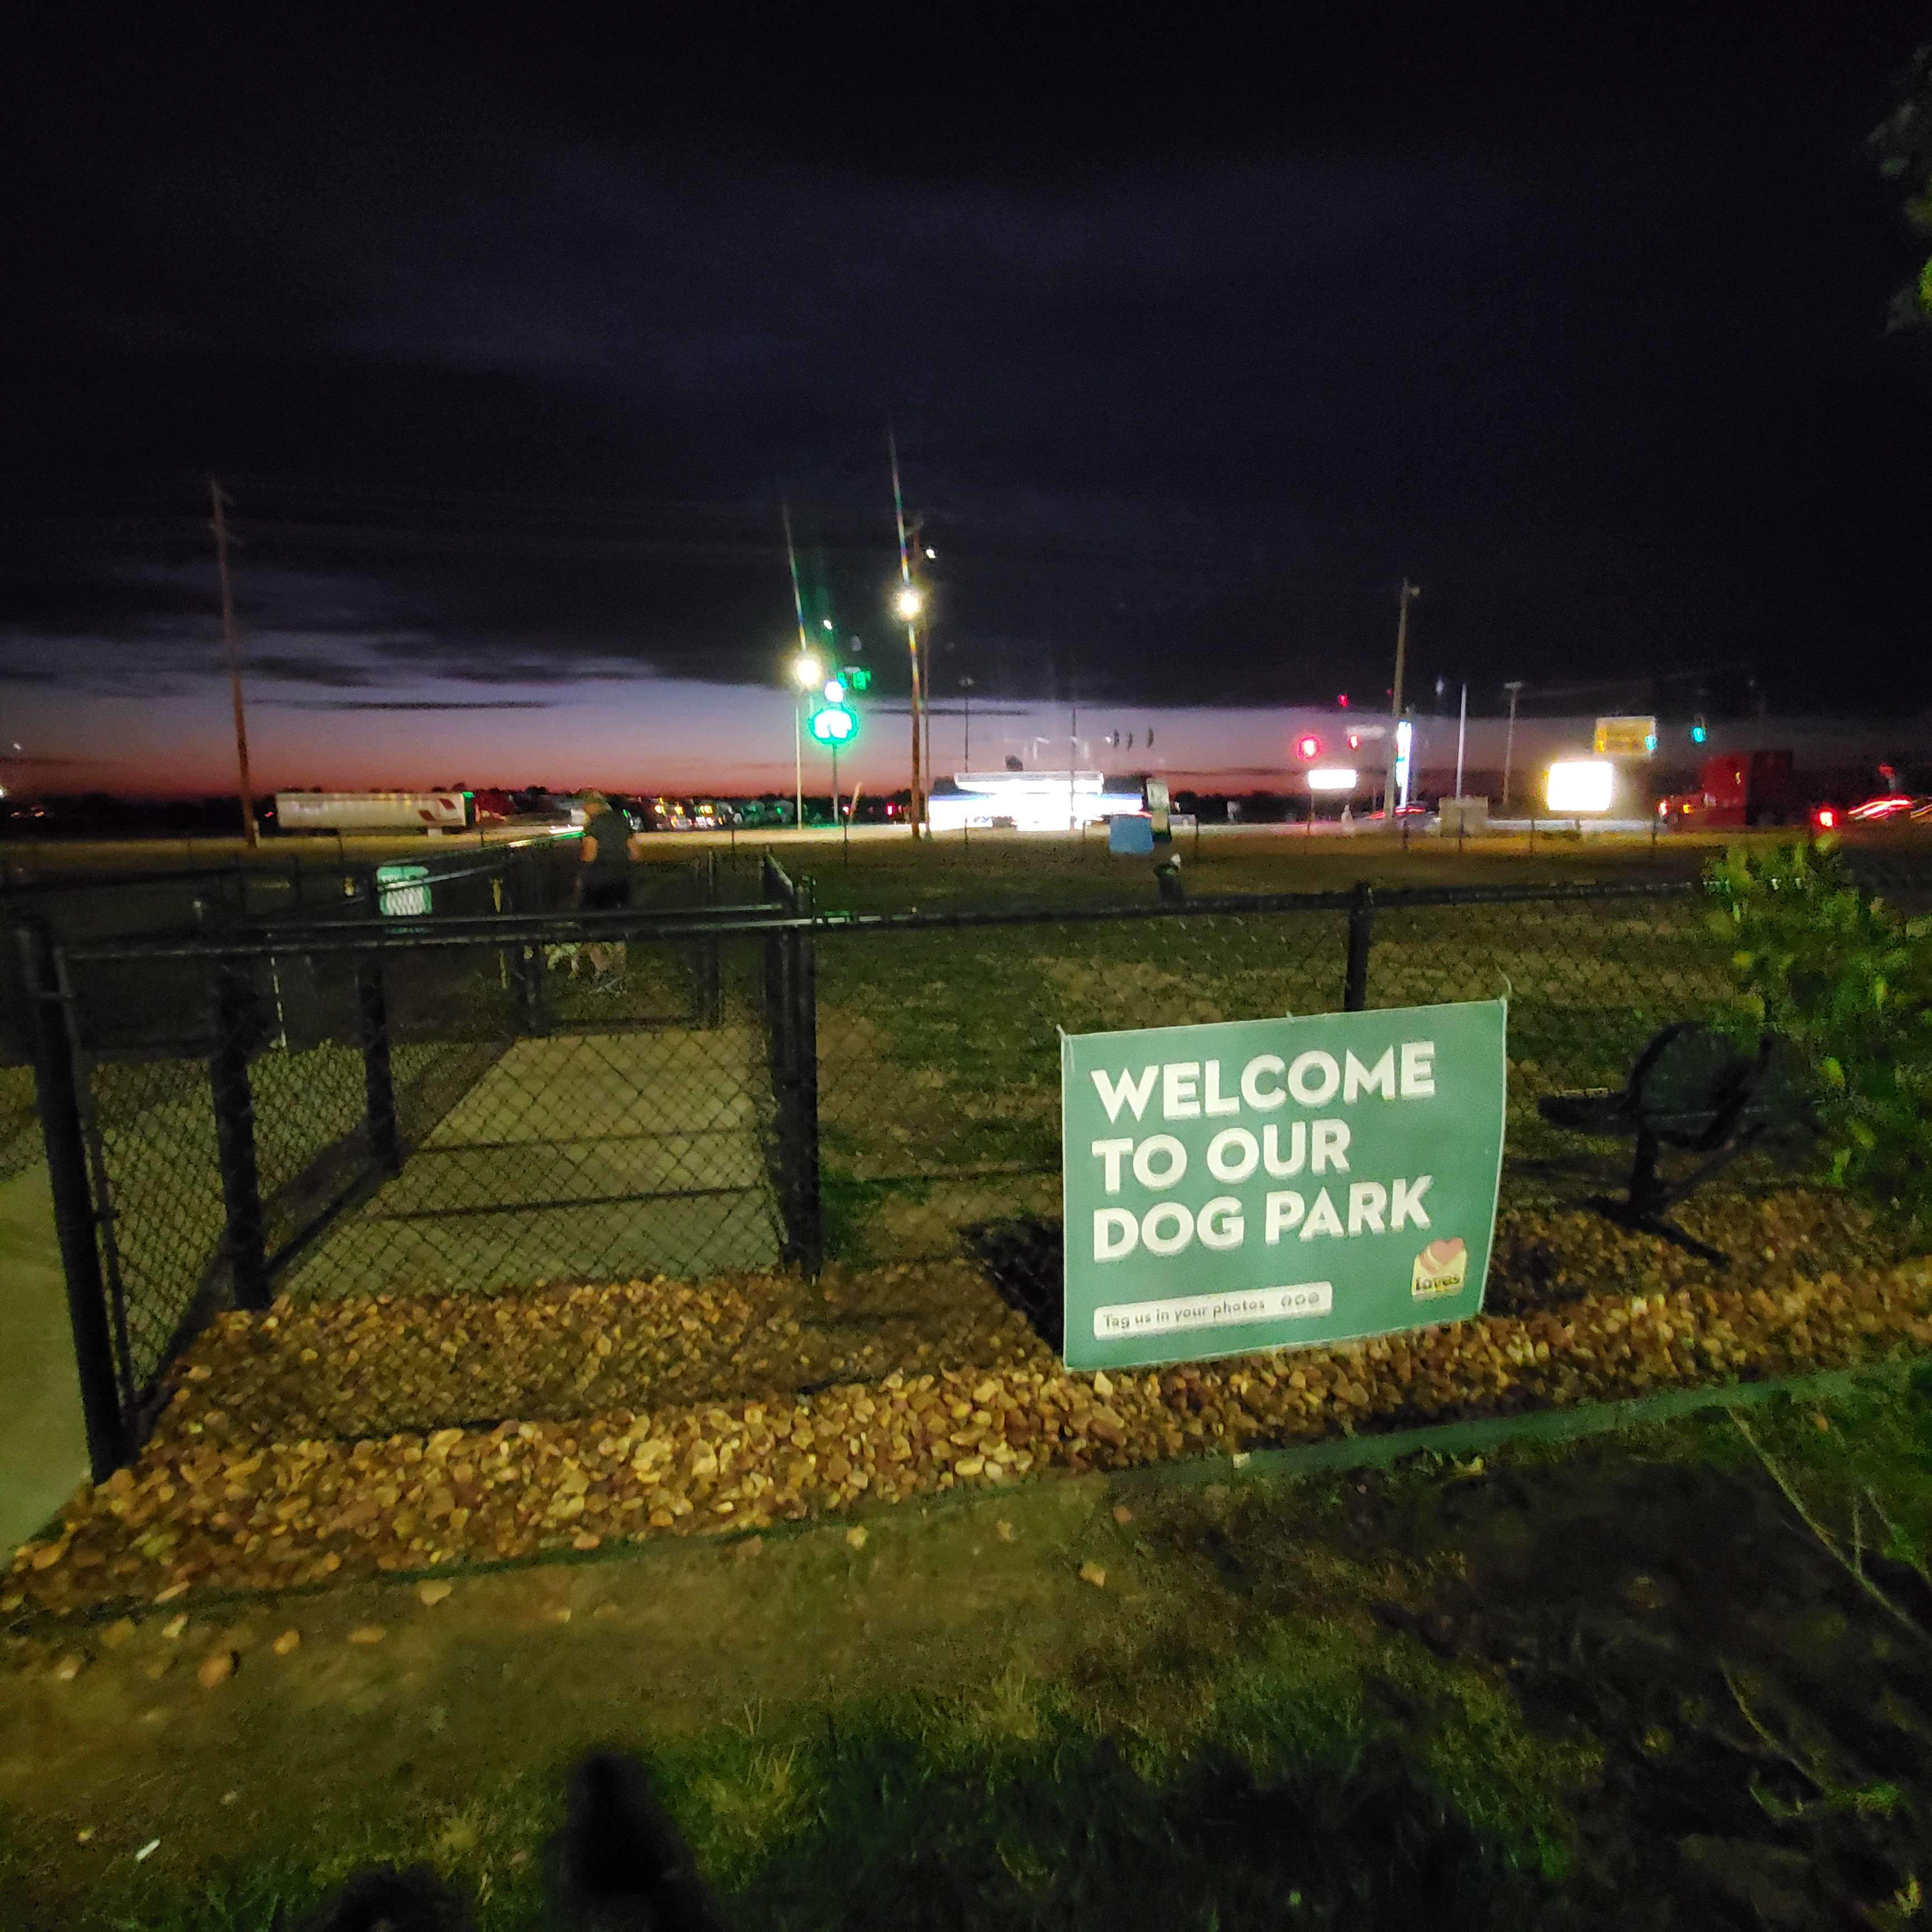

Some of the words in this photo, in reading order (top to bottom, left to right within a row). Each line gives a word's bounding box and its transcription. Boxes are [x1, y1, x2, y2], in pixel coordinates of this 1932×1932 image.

[1090, 1040, 1436, 1124] WELCOME
[1092, 1134, 1187, 1196] TO
[1207, 1119, 1351, 1185] OUR
[1093, 1196, 1245, 1263] DOG
[1265, 1175, 1433, 1245] PARK
[1103, 1314, 1129, 1329] Tag
[1135, 1314, 1151, 1324] us
[1156, 1309, 1169, 1323] in
[1175, 1307, 1207, 1322] your
[1213, 1298, 1265, 1318] photos
